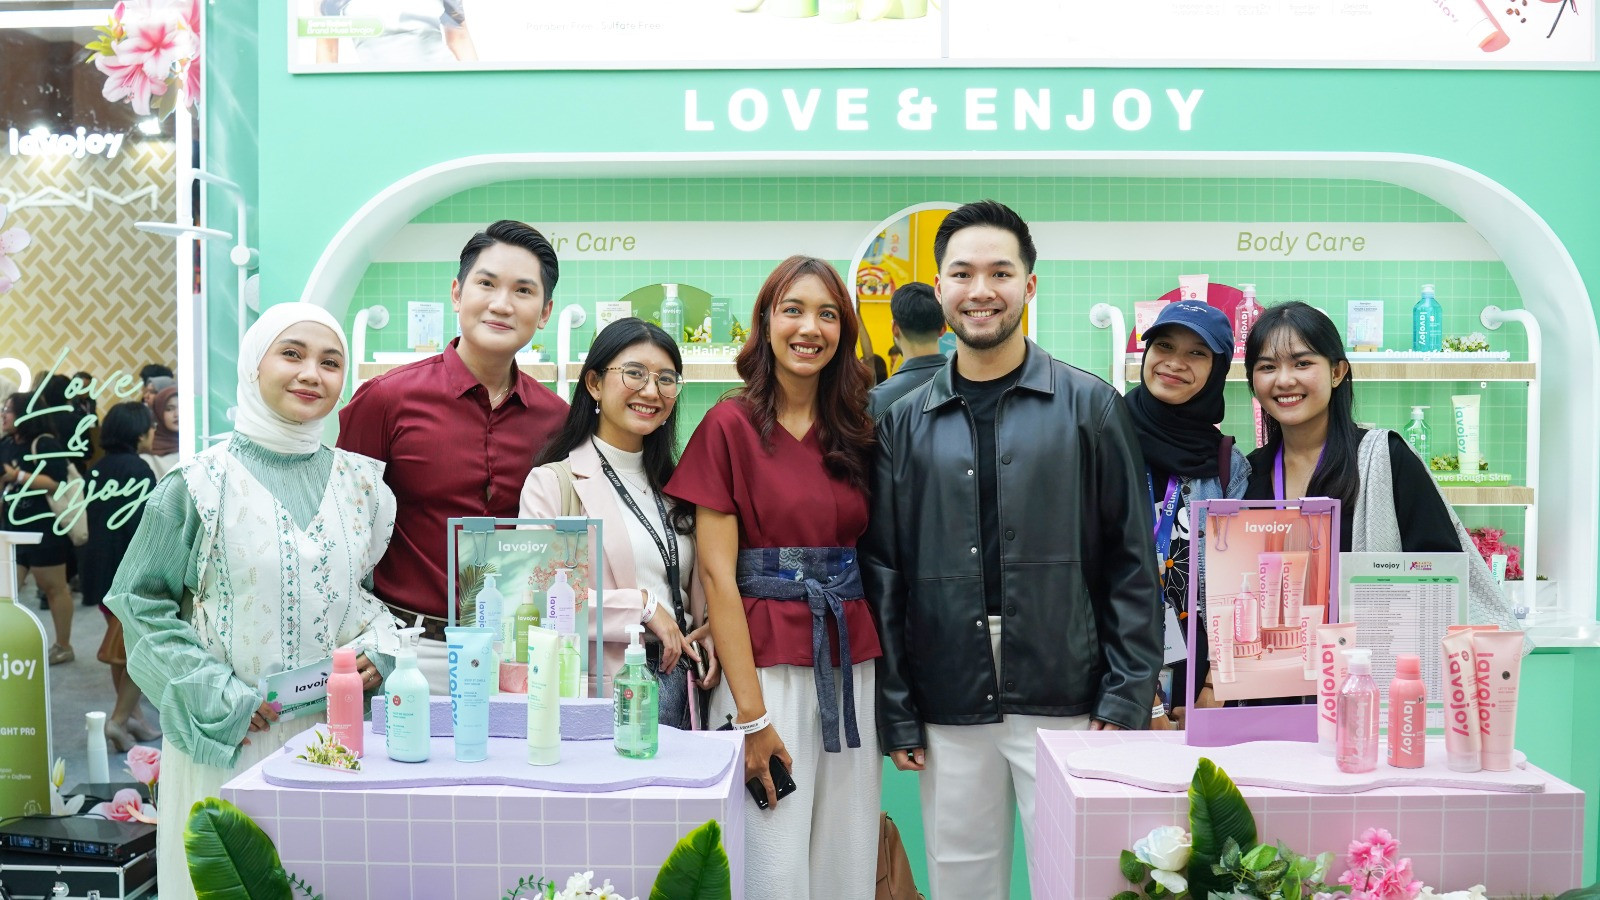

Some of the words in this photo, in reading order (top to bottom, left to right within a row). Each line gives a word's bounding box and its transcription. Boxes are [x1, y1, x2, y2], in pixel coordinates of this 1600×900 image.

[601, 20, 636, 31] Sulfate
[639, 20, 662, 30] Free
[684, 87, 869, 132] LOVE
[896, 87, 938, 131] &
[965, 87, 1204, 132] ENJOY
[9, 126, 124, 159] lavojoy
[550, 232, 569, 252] ir
[576, 232, 636, 252] Care
[1237, 231, 1299, 256] Body
[1306, 231, 1366, 252] Care
[679, 345, 719, 356] ti-Hair
[722, 345, 741, 356] Fa
[14, 346, 144, 427] Love
[67, 414, 98, 452] &
[1455, 406, 1468, 453] lavojoy
[1456, 473, 1488, 483] Rough
[1489, 473, 1509, 482] Skin
[4, 460, 153, 536] Enjoy
[1245, 521, 1293, 534] lavojoy
[498, 540, 549, 554] lavojoy
[1373, 561, 1400, 570] lavojoy
[1260, 562, 1269, 609] lavojoy
[1283, 562, 1292, 608] lavojoy
[549, 596, 557, 619] lavoj
[1213, 615, 1222, 662] lavojoy
[1302, 617, 1310, 661] lavojoy
[0, 653, 36, 680] joy
[295, 677, 329, 693] lavoj
[448, 644, 464, 727] lavojoy
[1322, 643, 1337, 725] lavojoy
[1448, 652, 1470, 737] lavojoy
[1476, 652, 1496, 736] lavojoy
[0, 727, 18, 736] GHT
[20, 727, 36, 736] PRO
[1400, 700, 1416, 756] lavojoy
